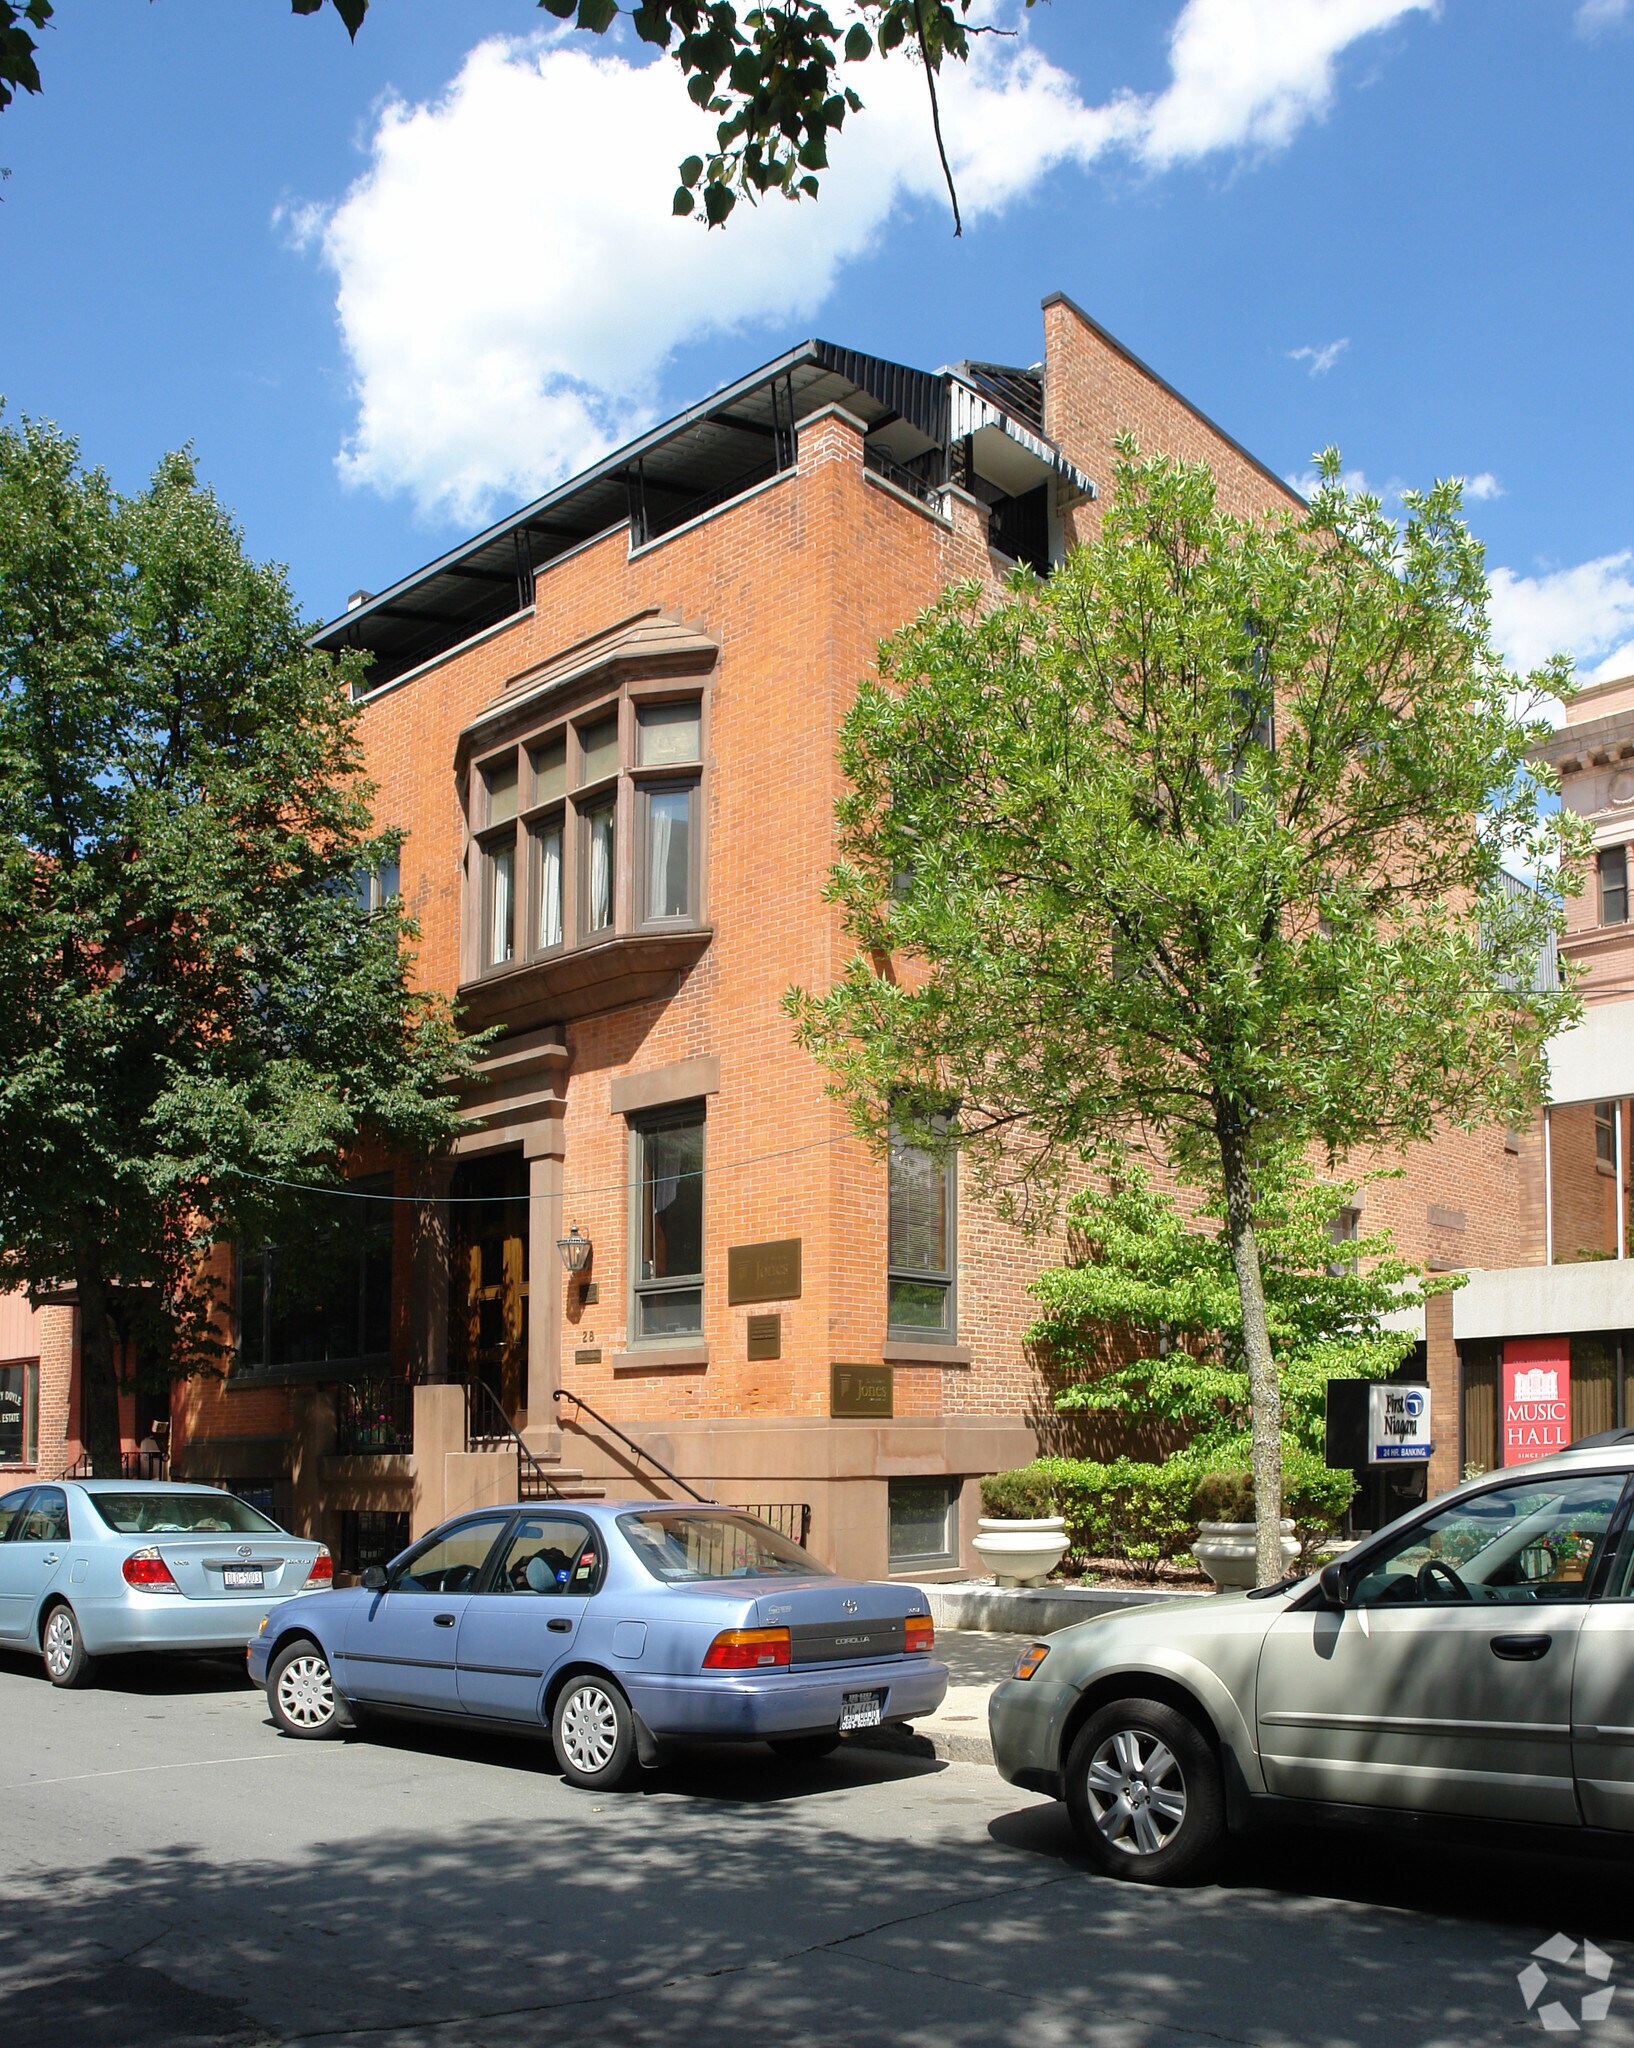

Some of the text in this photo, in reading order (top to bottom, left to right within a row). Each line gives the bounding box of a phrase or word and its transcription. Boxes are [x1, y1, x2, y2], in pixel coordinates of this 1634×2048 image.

[582, 1330, 595, 1343] 28
[5, 1390, 22, 1406] DOYLE
[856, 1379, 887, 1401] Jones
[1385, 1393, 1405, 1414] First
[1507, 1402, 1567, 1421] MUSIC
[2, 1412, 20, 1423] ESTATE
[1384, 1415, 1417, 1443] Niagara
[1507, 1426, 1567, 1445] HALL
[1383, 1449, 1391, 1457] 24
[1401, 1448, 1426, 1457] BANKING
[835, 1635, 870, 1645] COROLLA
